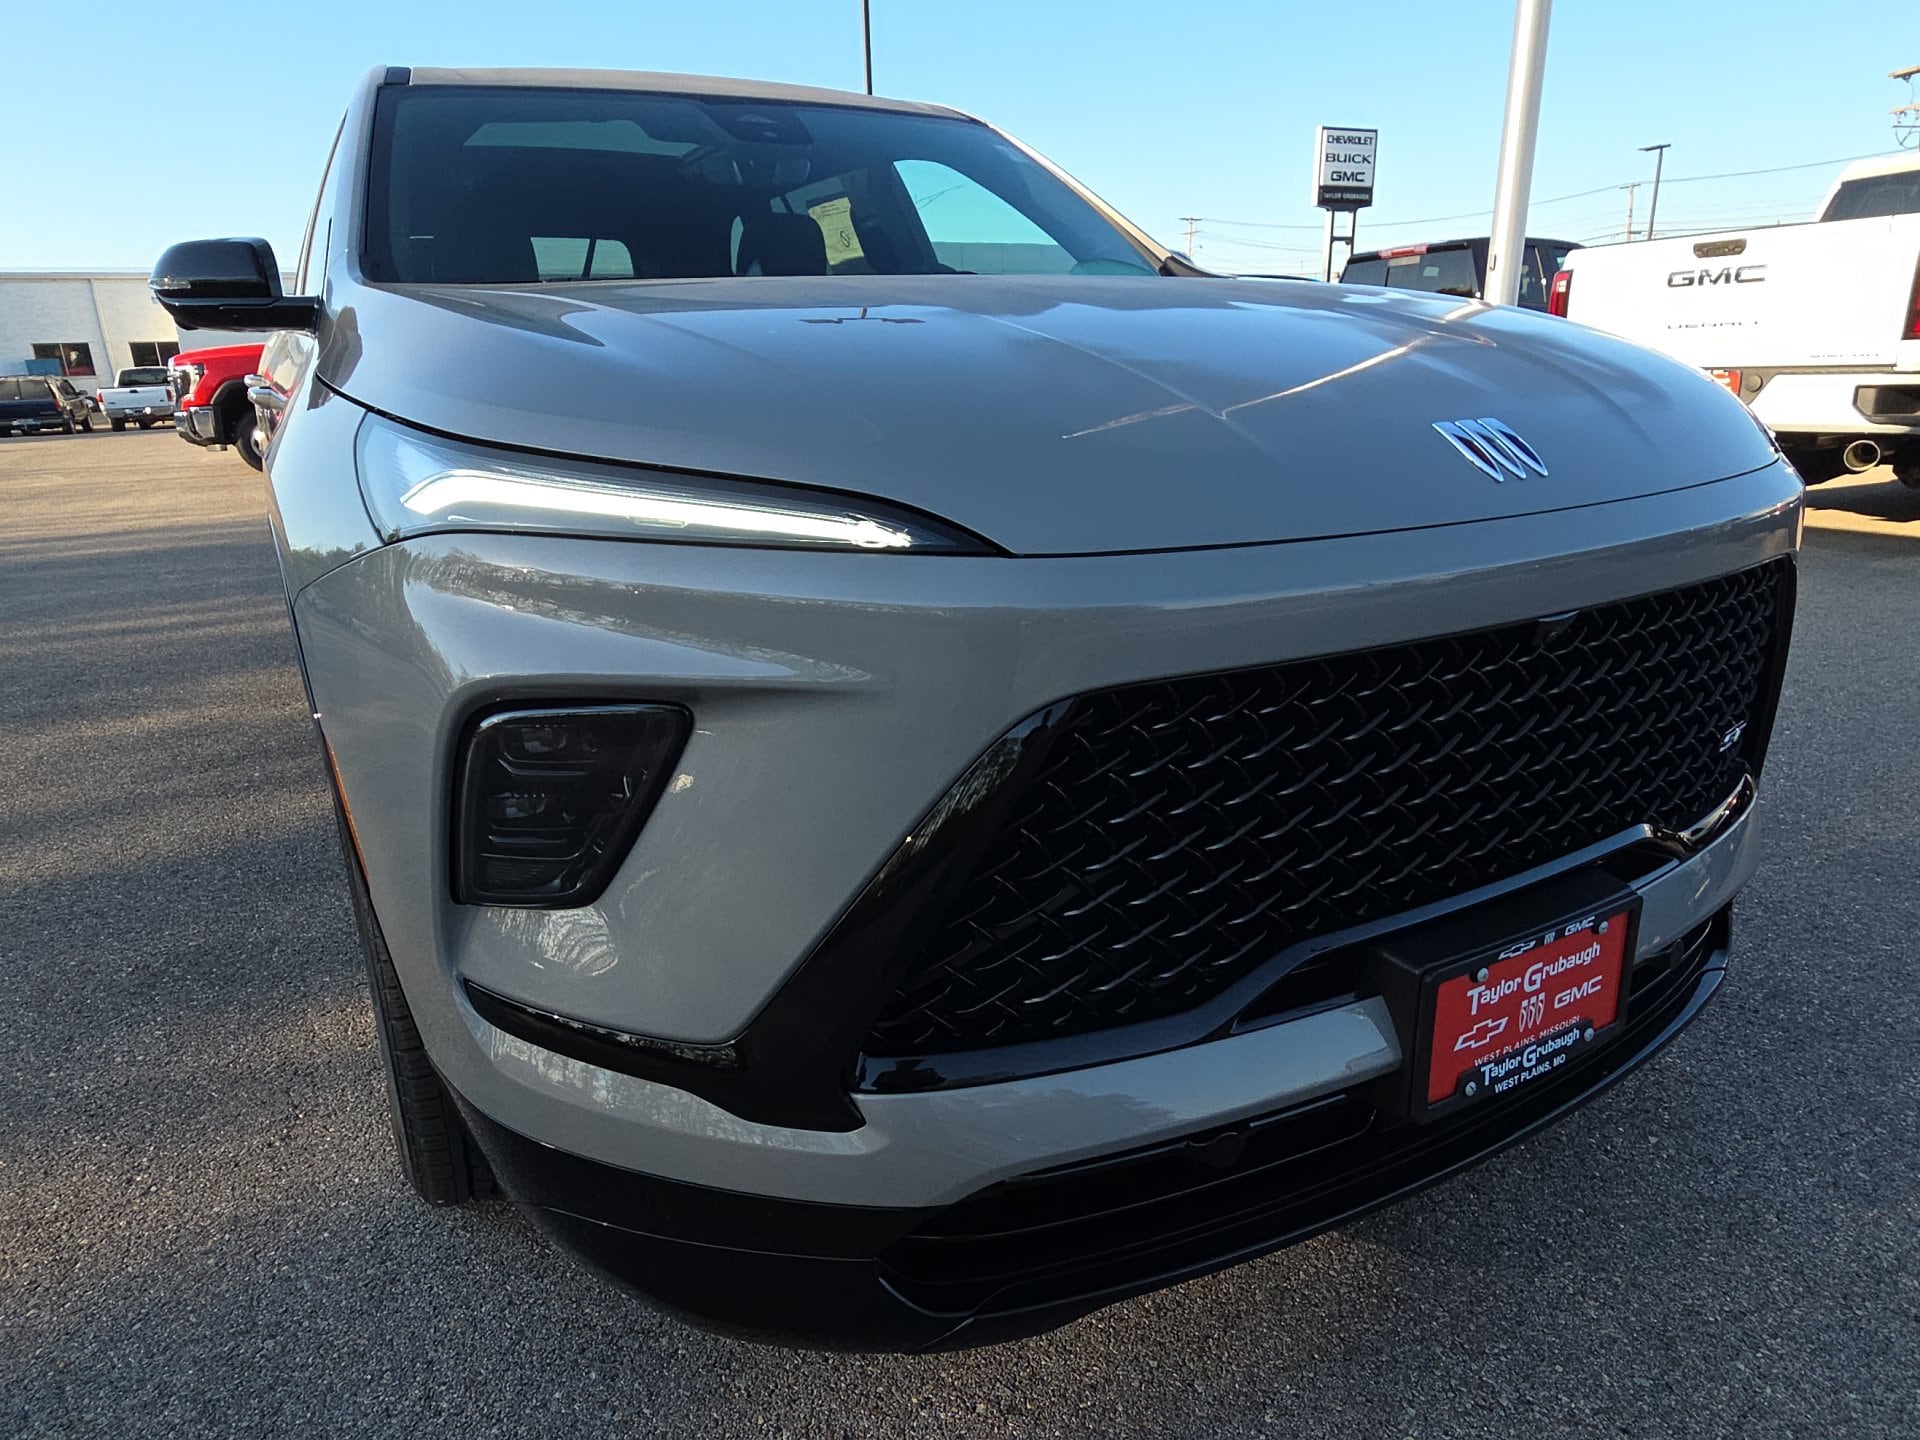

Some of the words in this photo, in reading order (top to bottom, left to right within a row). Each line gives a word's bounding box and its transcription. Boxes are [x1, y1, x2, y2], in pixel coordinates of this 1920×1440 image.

[1327, 134, 1374, 146] CHEVROLET
[1325, 152, 1372, 164] BUICK
[1330, 170, 1366, 182] GMC
[1667, 264, 1767, 288] GMC
[1565, 916, 1595, 936] GMC
[1467, 977, 1521, 1016] Taylor
[1523, 941, 1601, 993] Grubaugh
[1554, 975, 1603, 1009] GMC
[1474, 1049, 1501, 1066] WEST
[1540, 1015, 1580, 1039] MISSOURI
[1481, 1055, 1521, 1086] Taylor
[1522, 1028, 1580, 1068] Grubaugh
[1494, 1075, 1520, 1094] WEST
[1520, 1061, 1552, 1082] PLAINS,
[1553, 1053, 1566, 1067] MO
